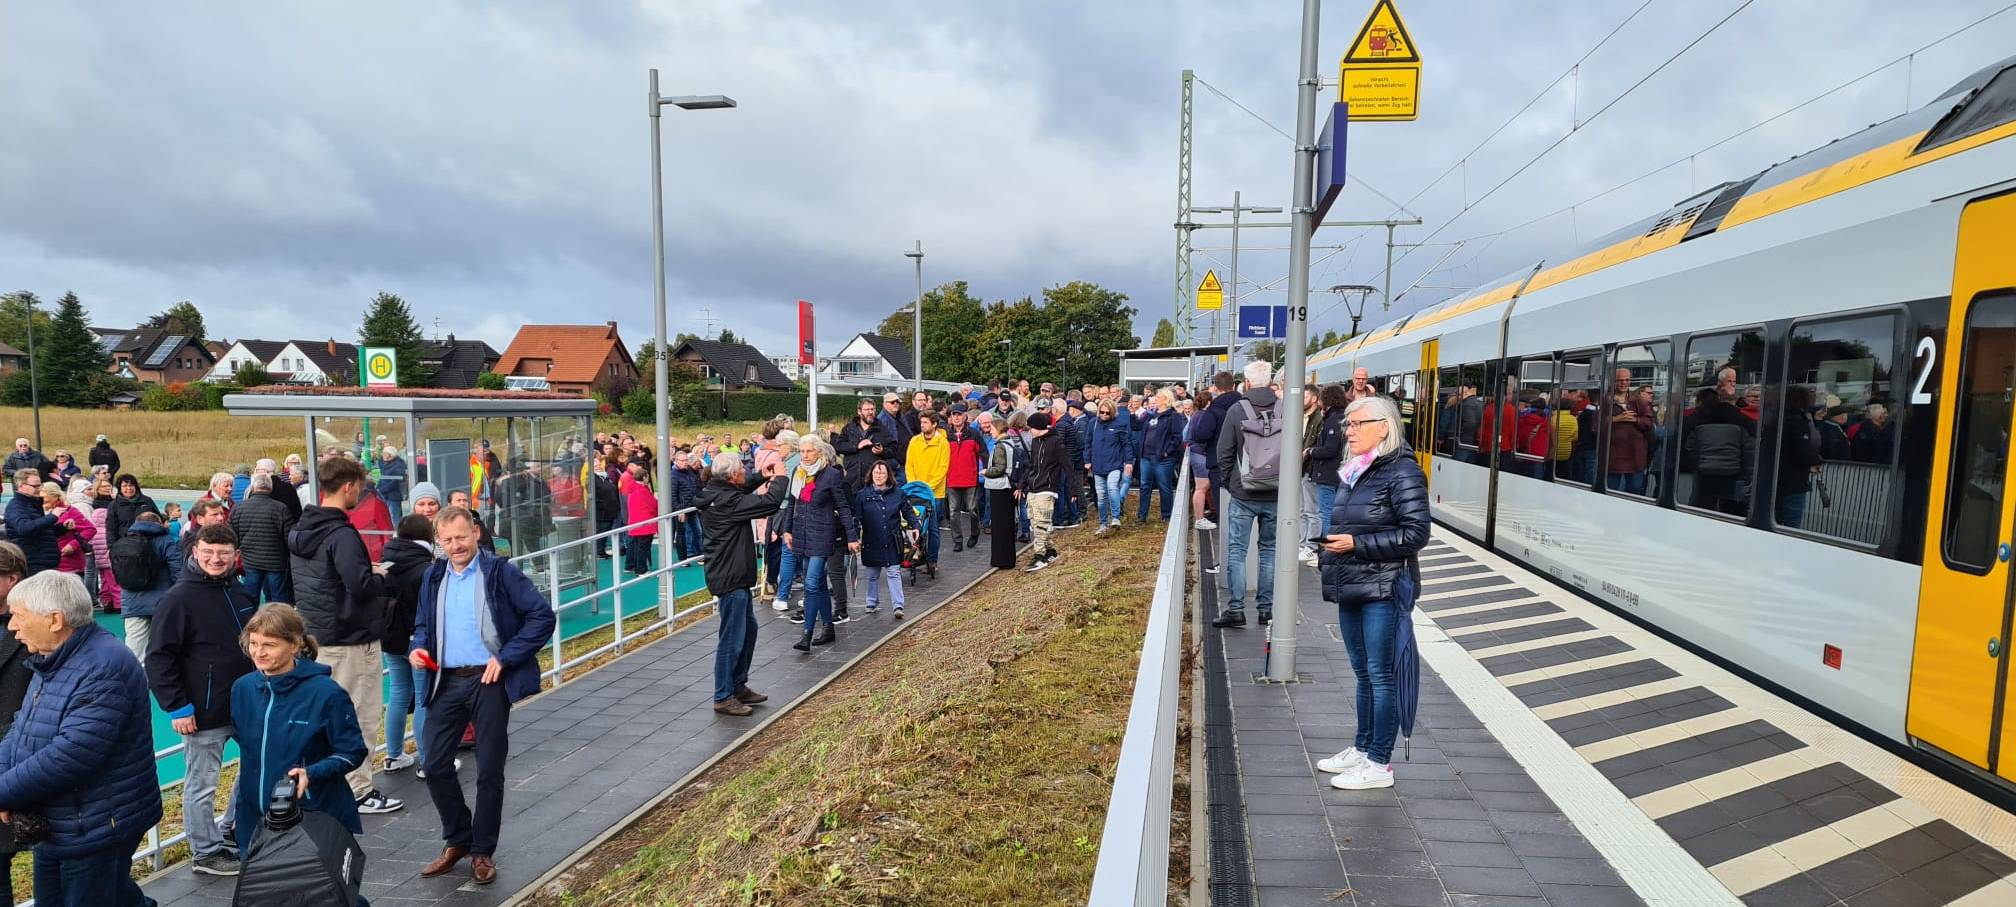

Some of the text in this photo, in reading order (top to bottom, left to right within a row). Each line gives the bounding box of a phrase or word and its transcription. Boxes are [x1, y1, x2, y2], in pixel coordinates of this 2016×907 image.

[1289, 306, 1306, 321] 19
[376, 358, 385, 373] H
[1911, 336, 1936, 404] 2
